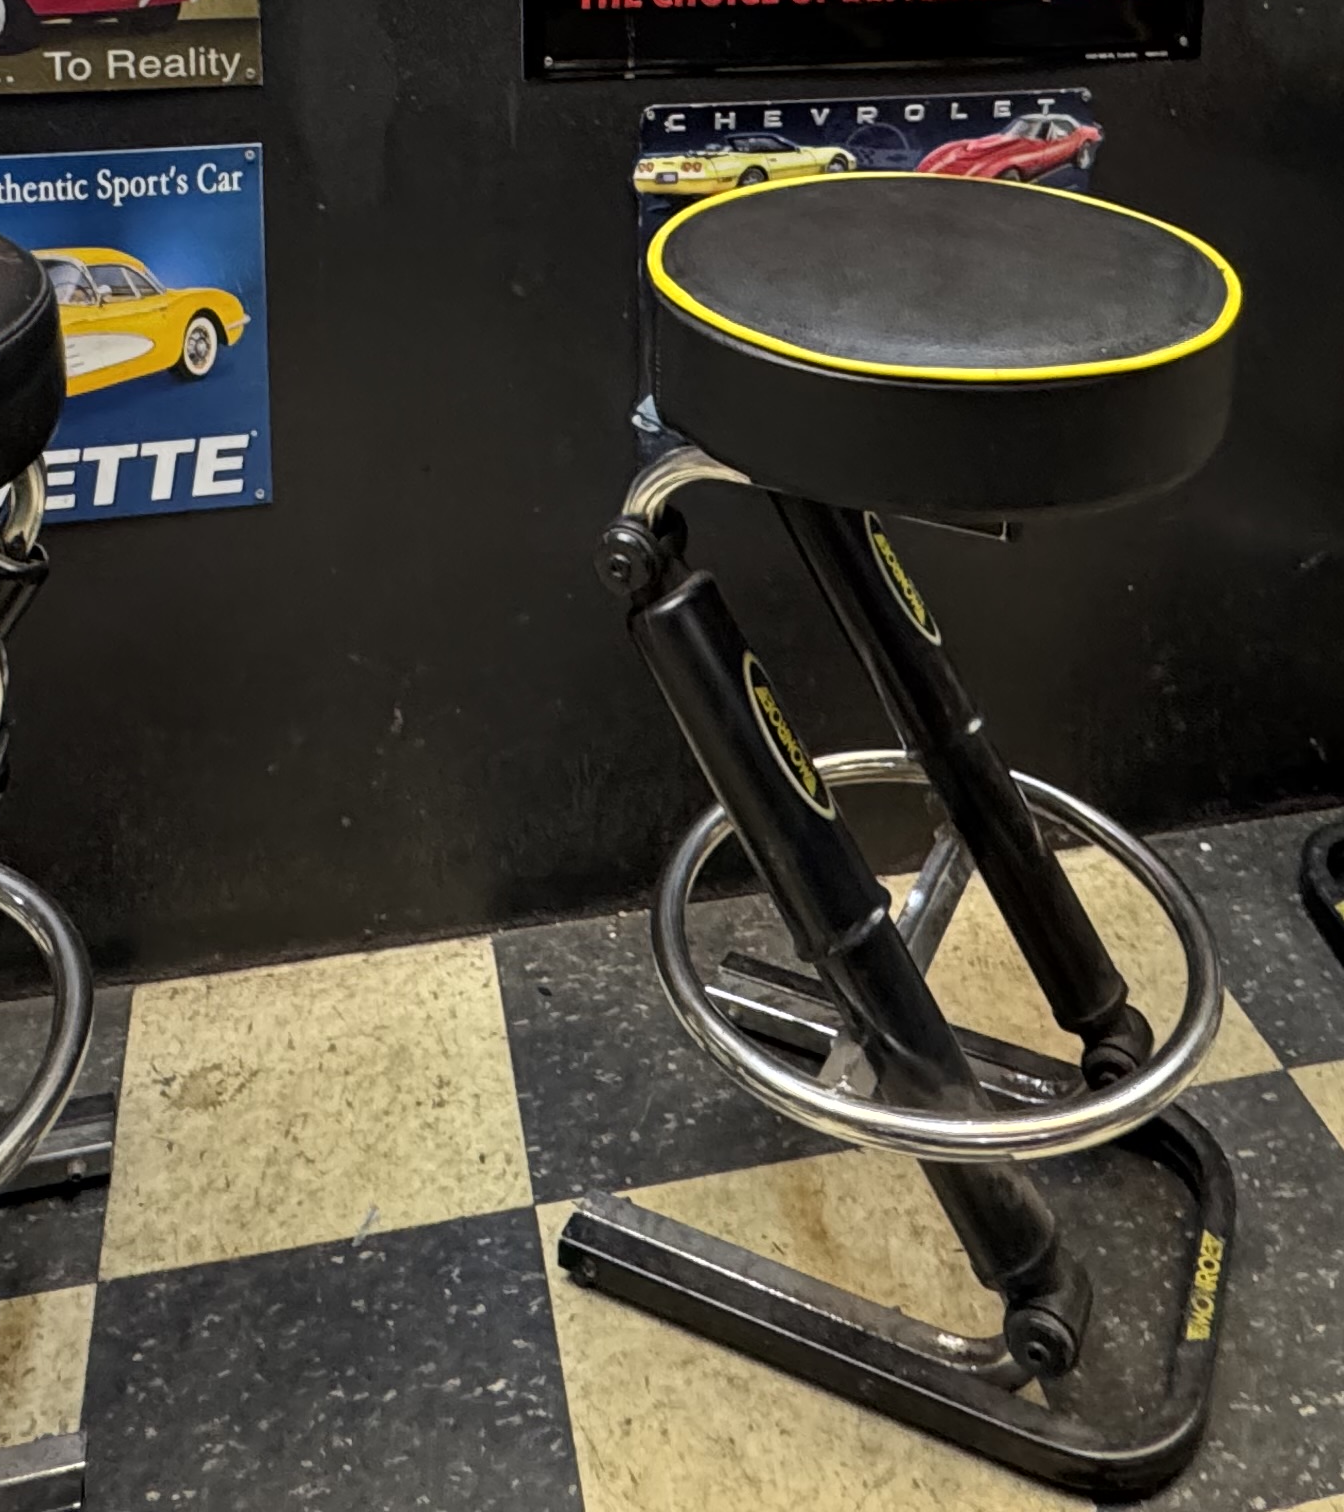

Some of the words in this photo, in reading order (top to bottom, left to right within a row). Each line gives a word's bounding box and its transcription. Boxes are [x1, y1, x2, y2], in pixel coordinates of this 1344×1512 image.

[43, 50, 92, 82] To
[108, 47, 241, 84] Reality
[665, 98, 1057, 133] CHEVROLET
[96, 167, 188, 206] Sport's
[197, 165, 243, 193] Car
